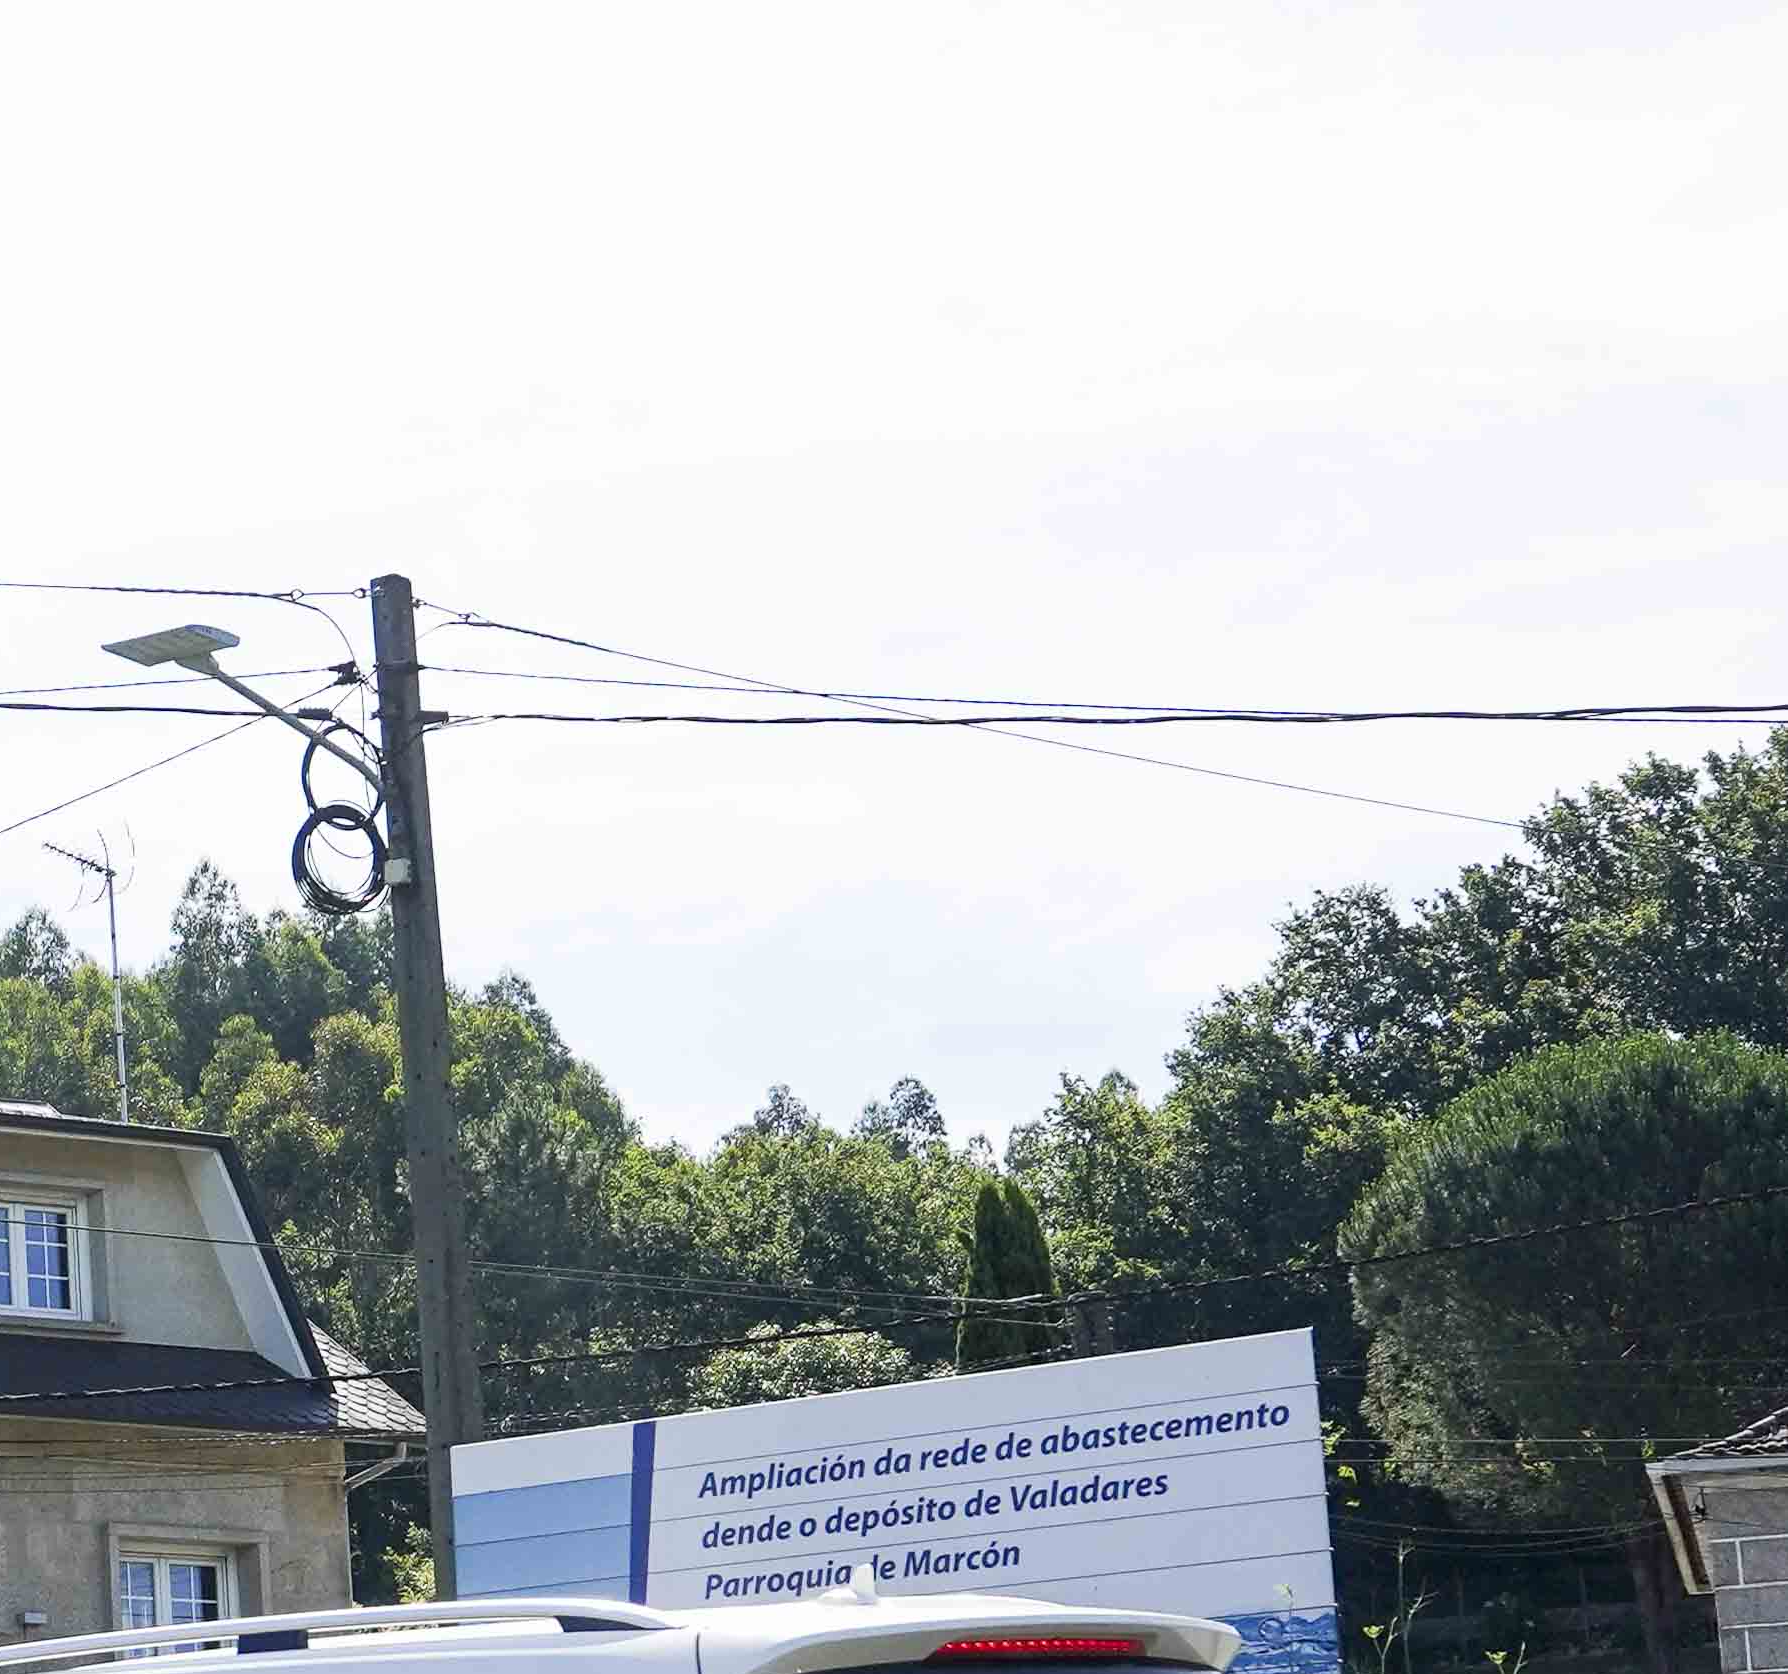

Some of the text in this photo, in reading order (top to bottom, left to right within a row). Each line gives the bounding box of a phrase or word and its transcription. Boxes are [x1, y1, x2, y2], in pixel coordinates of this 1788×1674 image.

[697, 1402, 1291, 1499] Ampliación da rede de abastecemento
[701, 1473, 1169, 1549] dende o depósito de Valadares
[704, 1560, 854, 1600] Parroquia
[903, 1541, 1022, 1578] Marcón
